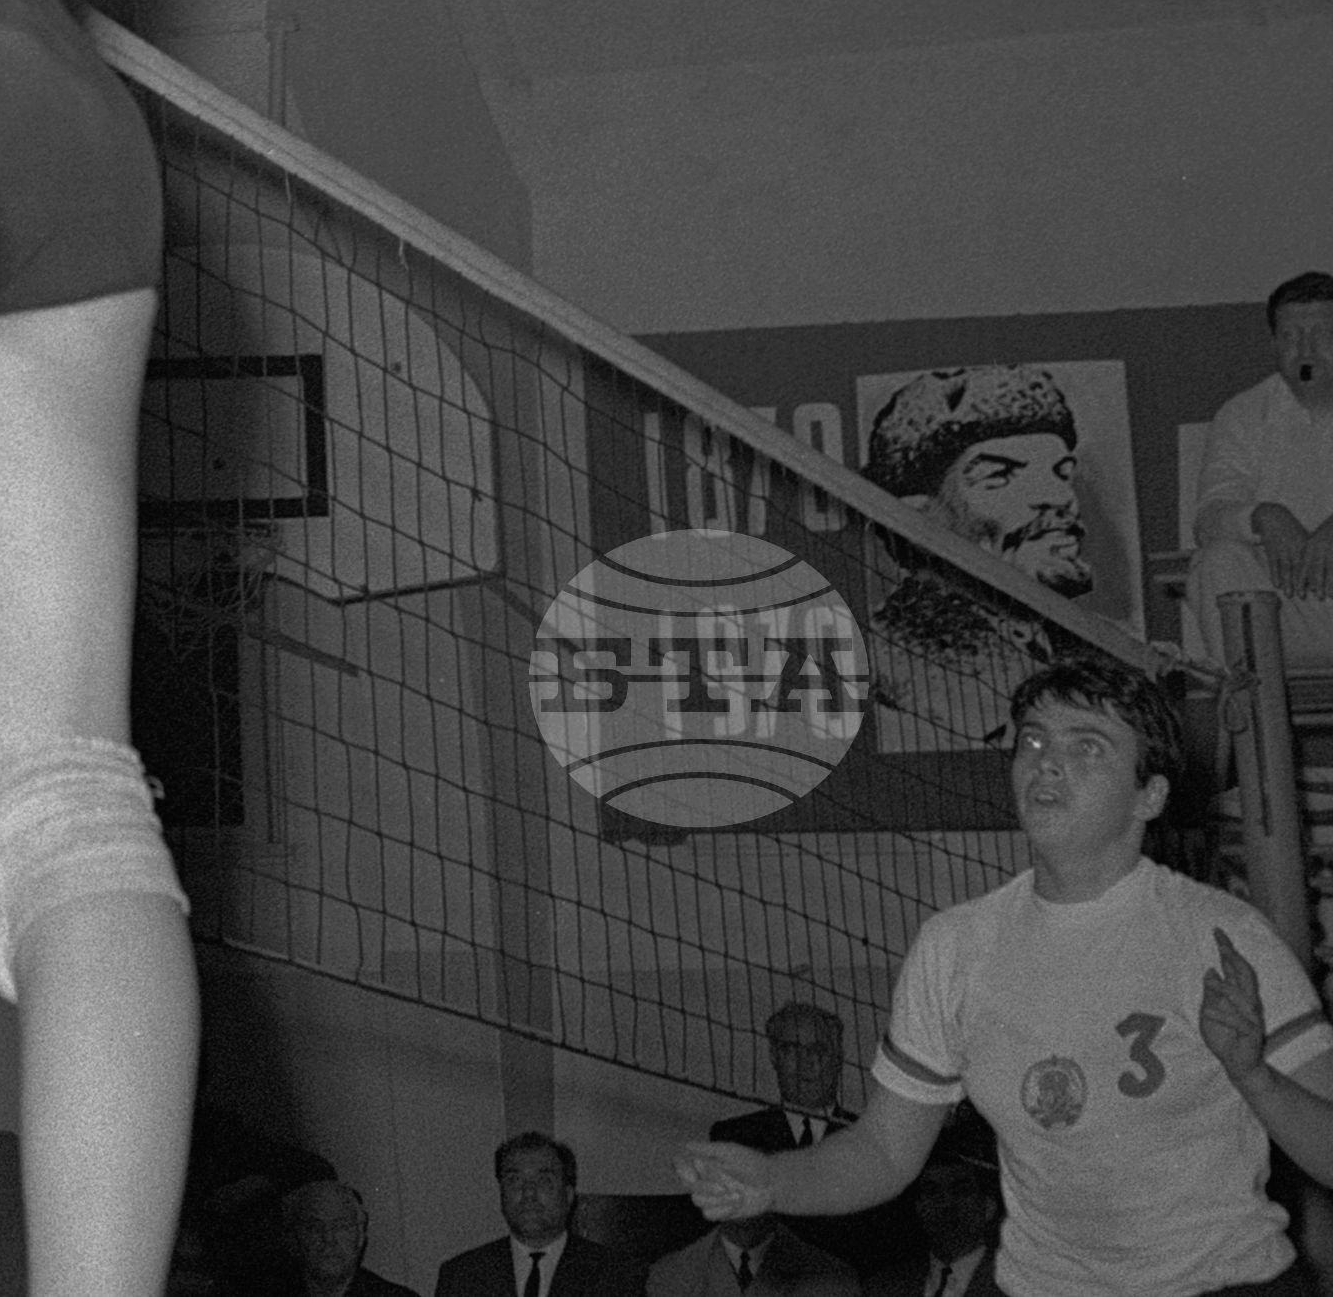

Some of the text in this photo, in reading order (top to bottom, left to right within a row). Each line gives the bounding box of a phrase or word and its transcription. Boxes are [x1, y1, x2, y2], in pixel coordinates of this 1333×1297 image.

[643, 402, 848, 540] 1870
[658, 603, 863, 740] 1970
[1115, 1011, 1167, 1099] 3
